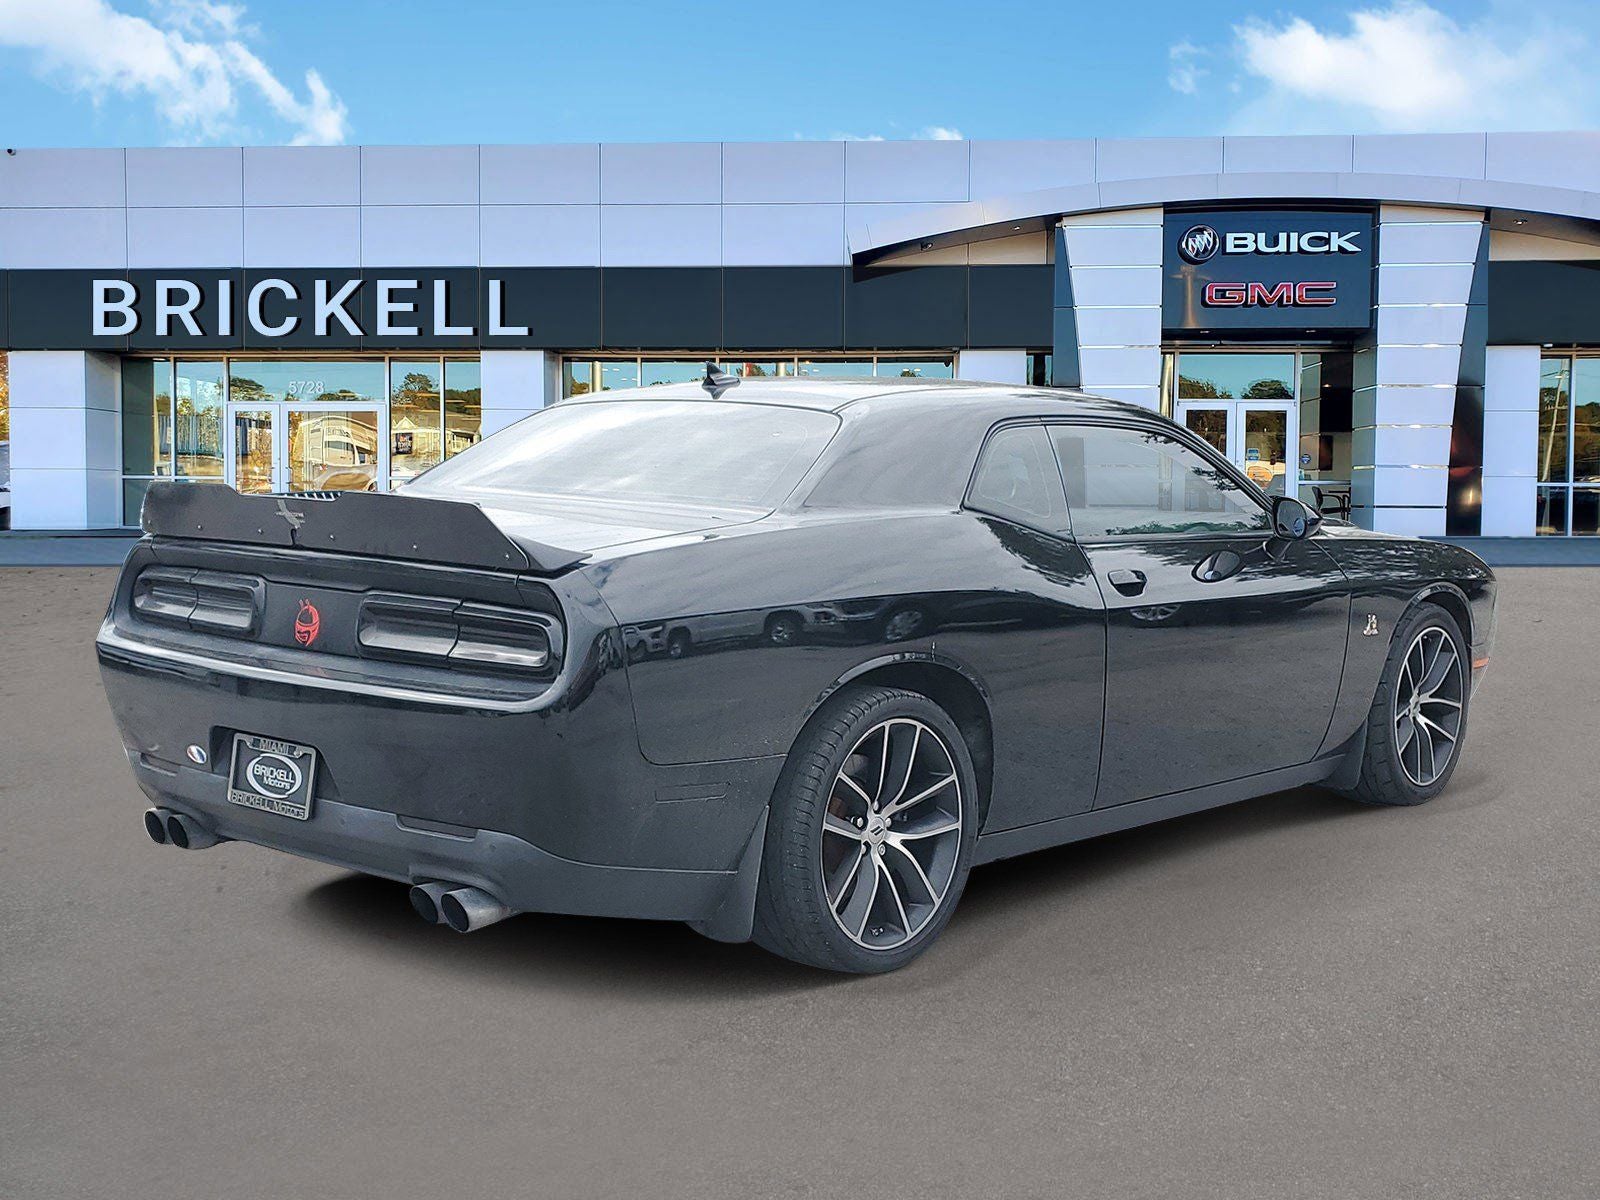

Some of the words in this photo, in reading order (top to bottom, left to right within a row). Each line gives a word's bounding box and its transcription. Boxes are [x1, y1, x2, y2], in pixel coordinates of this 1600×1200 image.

[1225, 231, 1361, 254] BUICK
[1204, 280, 1337, 307] GMC
[92, 279, 529, 336] BRICKELL
[289, 380, 325, 394] 5728
[261, 740, 289, 754] MIAMI
[254, 764, 294, 783] BRICKELL
[232, 792, 270, 809] BRICKELL
